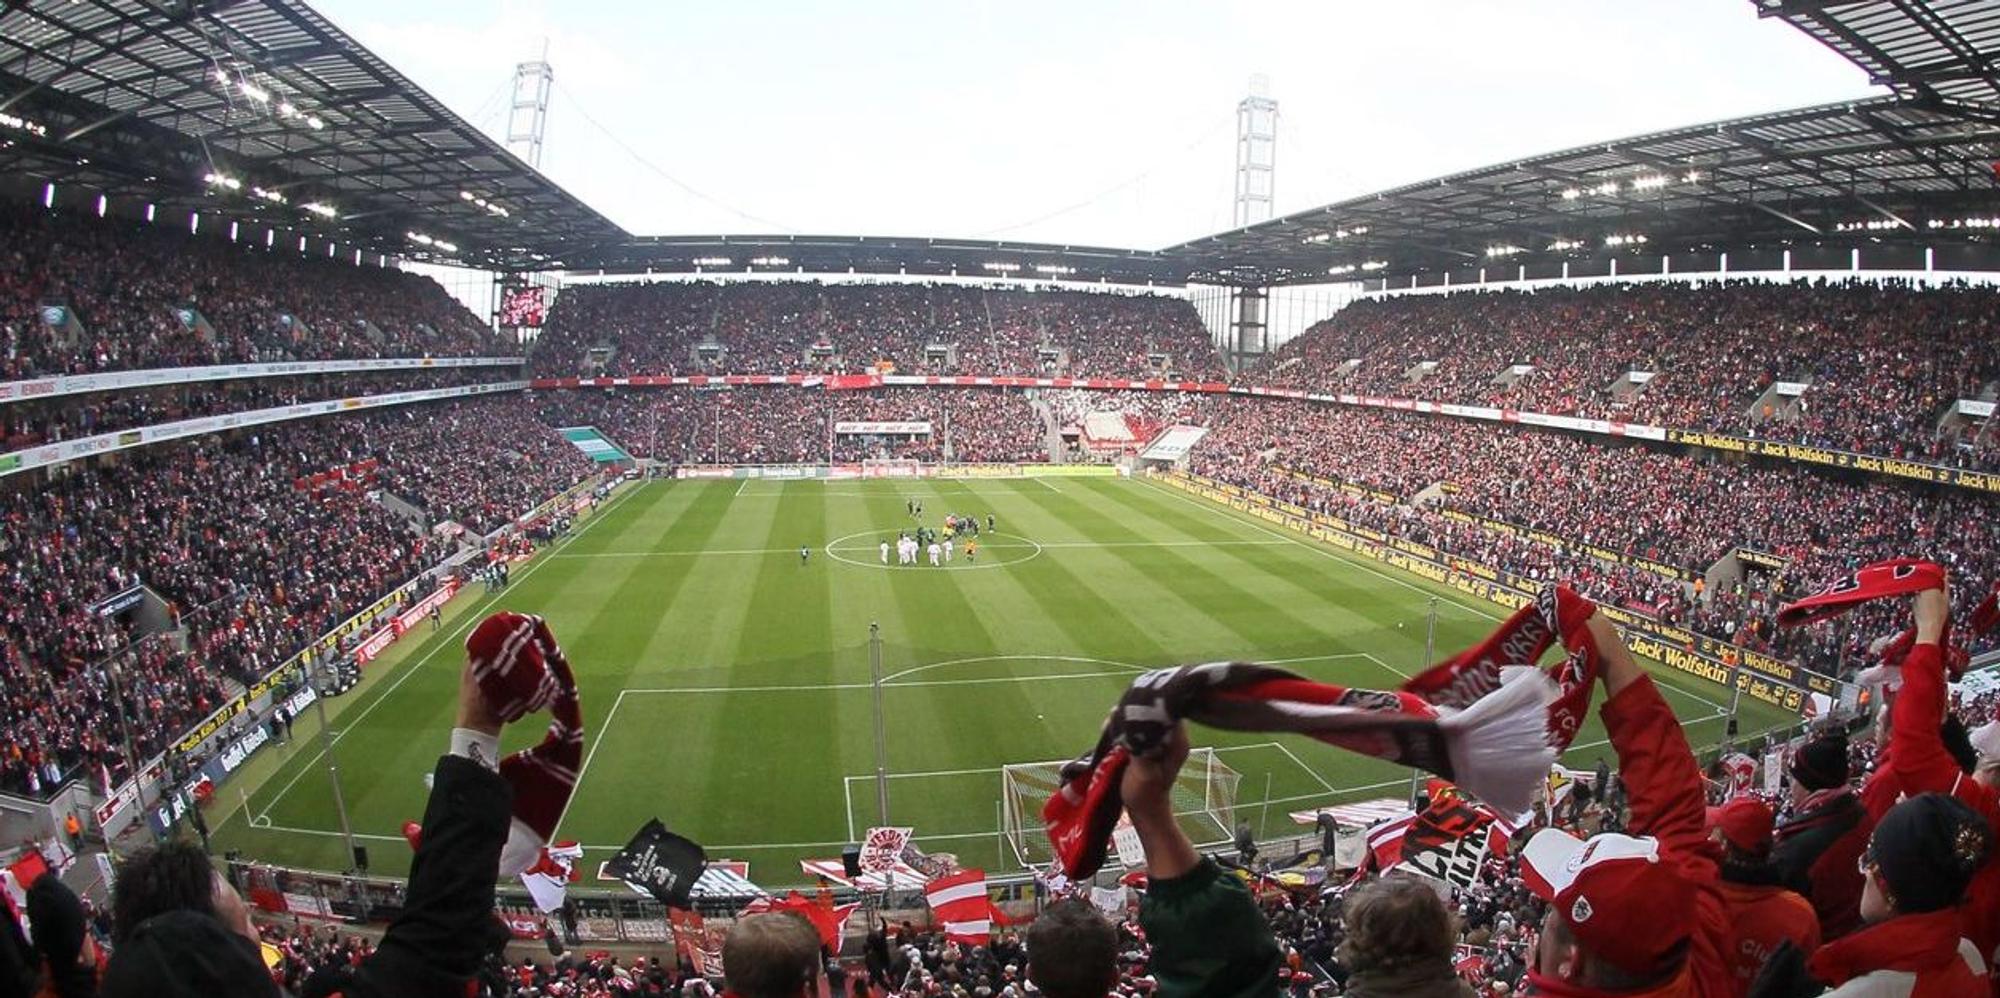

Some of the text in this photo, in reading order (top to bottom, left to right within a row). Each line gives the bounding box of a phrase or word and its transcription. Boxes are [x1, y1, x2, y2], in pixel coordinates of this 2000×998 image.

[1680, 431, 1744, 450] Jack Wolfskin
[1761, 442, 1833, 464] Jack Wolfskin
[1853, 456, 1933, 480] Jack Wolfskin
[1955, 472, 1984, 489] Jack
[1387, 551, 1446, 583] Jack Wolfskin
[1491, 588, 1516, 609] Jack
[1629, 637, 1728, 685] Jack Wolfskin
[1744, 653, 1792, 679] Wolfskin
